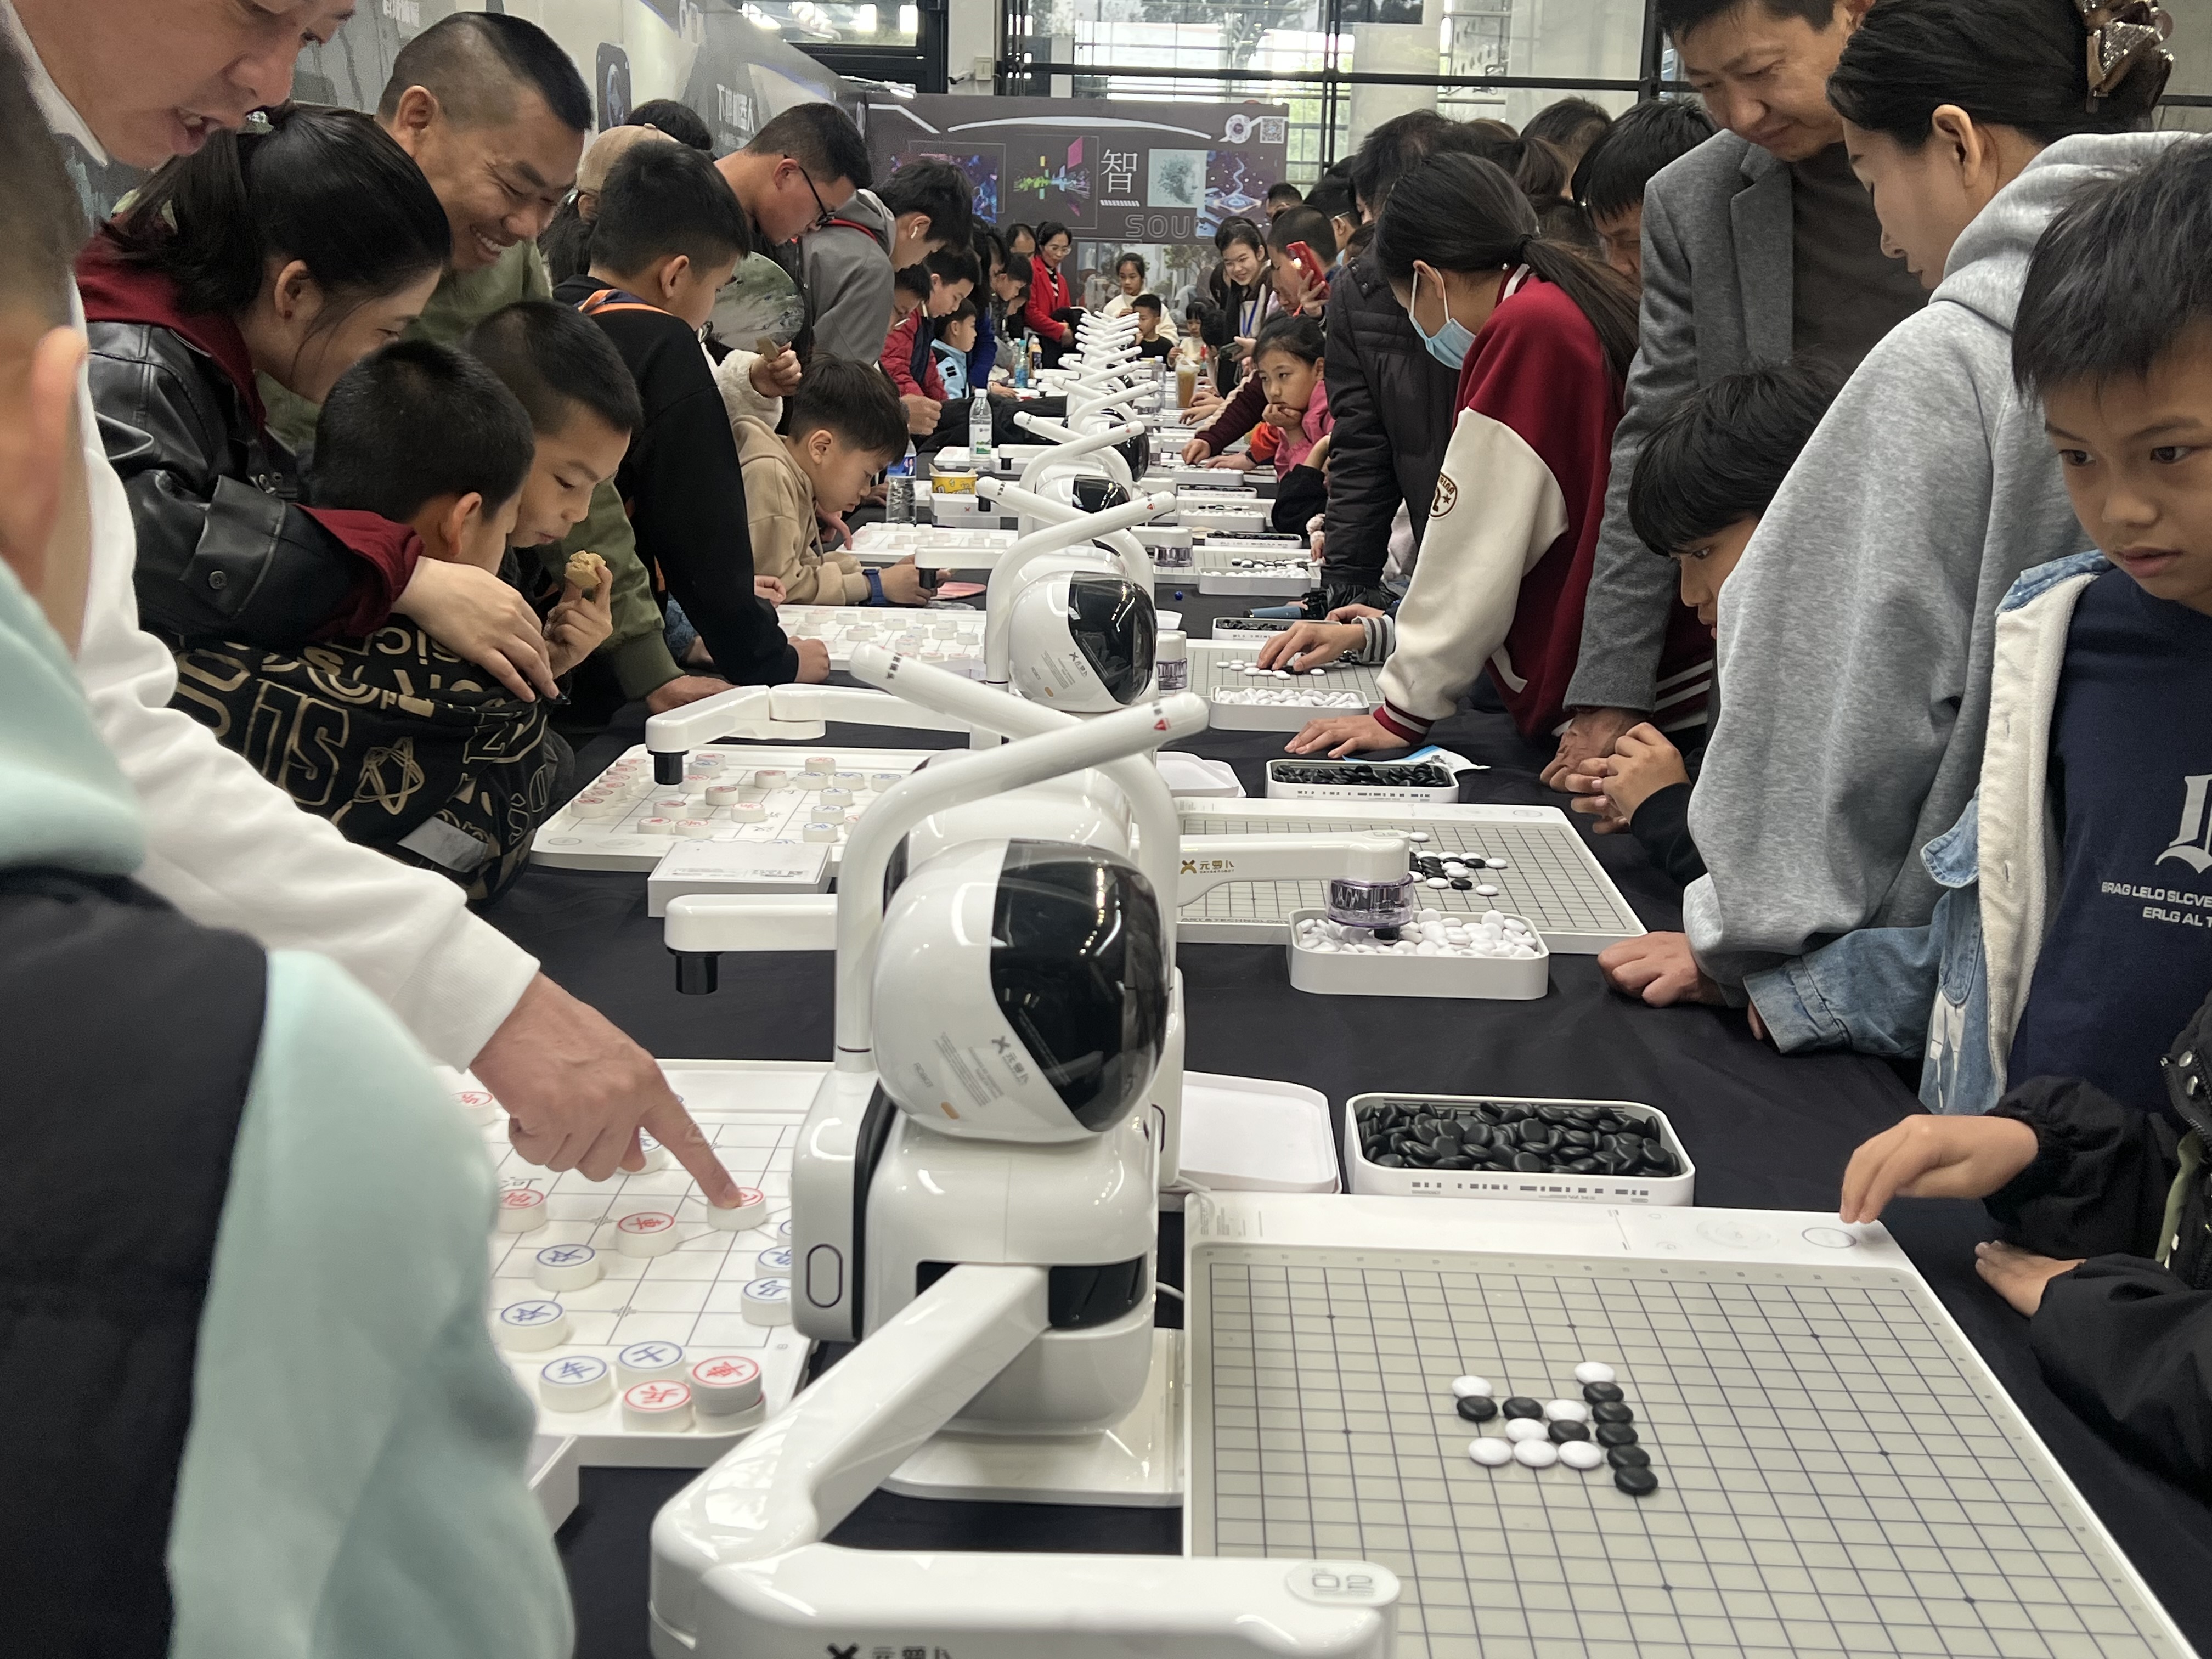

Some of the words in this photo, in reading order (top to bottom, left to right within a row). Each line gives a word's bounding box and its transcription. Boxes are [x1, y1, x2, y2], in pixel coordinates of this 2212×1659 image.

[1101, 149, 1138, 193] 智
[1125, 214, 1208, 239] SOU
[2101, 881, 2131, 896] ERAG
[2132, 885, 2165, 901] LELO
[2142, 906, 2181, 923] ERLG
[2182, 912, 2203, 927] AL
